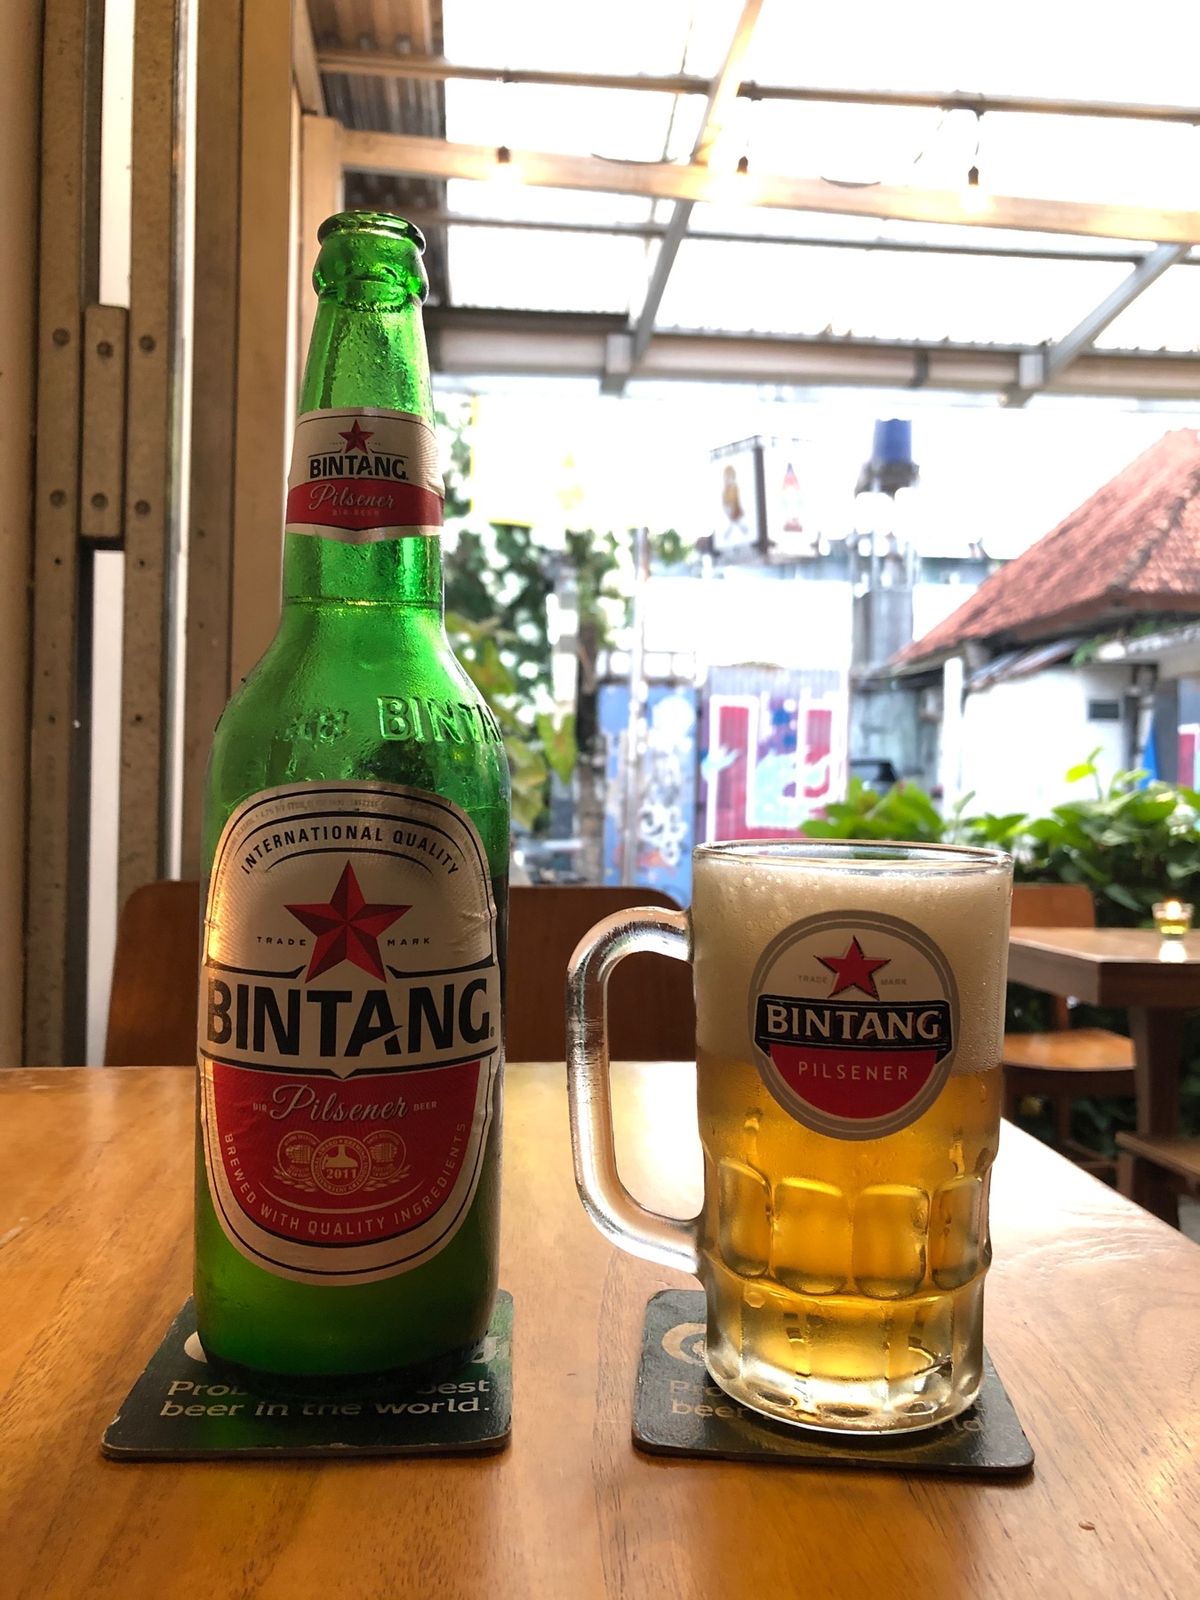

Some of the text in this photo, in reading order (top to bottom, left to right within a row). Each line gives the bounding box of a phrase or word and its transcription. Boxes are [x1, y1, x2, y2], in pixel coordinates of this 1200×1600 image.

[309, 455, 407, 480] BINTANG
[308, 483, 395, 510] Pilsener
[240, 825, 383, 875] INTERNATIONAL
[393, 830, 459, 875] QUALITY
[257, 936, 431, 946] TRADE MARK
[798, 975, 907, 986] TRADE MARK
[206, 978, 491, 1058] BINTANG
[766, 1003, 941, 1041] BINTANG
[798, 1061, 909, 1081] PILSENER
[269, 1083, 409, 1122] Pilsener
[413, 1101, 438, 1112] BEER
[224, 1133, 256, 1204] BREWED
[260, 1203, 299, 1230] WITH
[307, 1216, 385, 1235] QUALITY
[393, 1122, 466, 1225] INGREDIENTS
[326, 1168, 357, 1179] 2011
[159, 1400, 245, 1417] beer
[254, 1401, 289, 1416] in
[375, 1397, 490, 1415] world.
